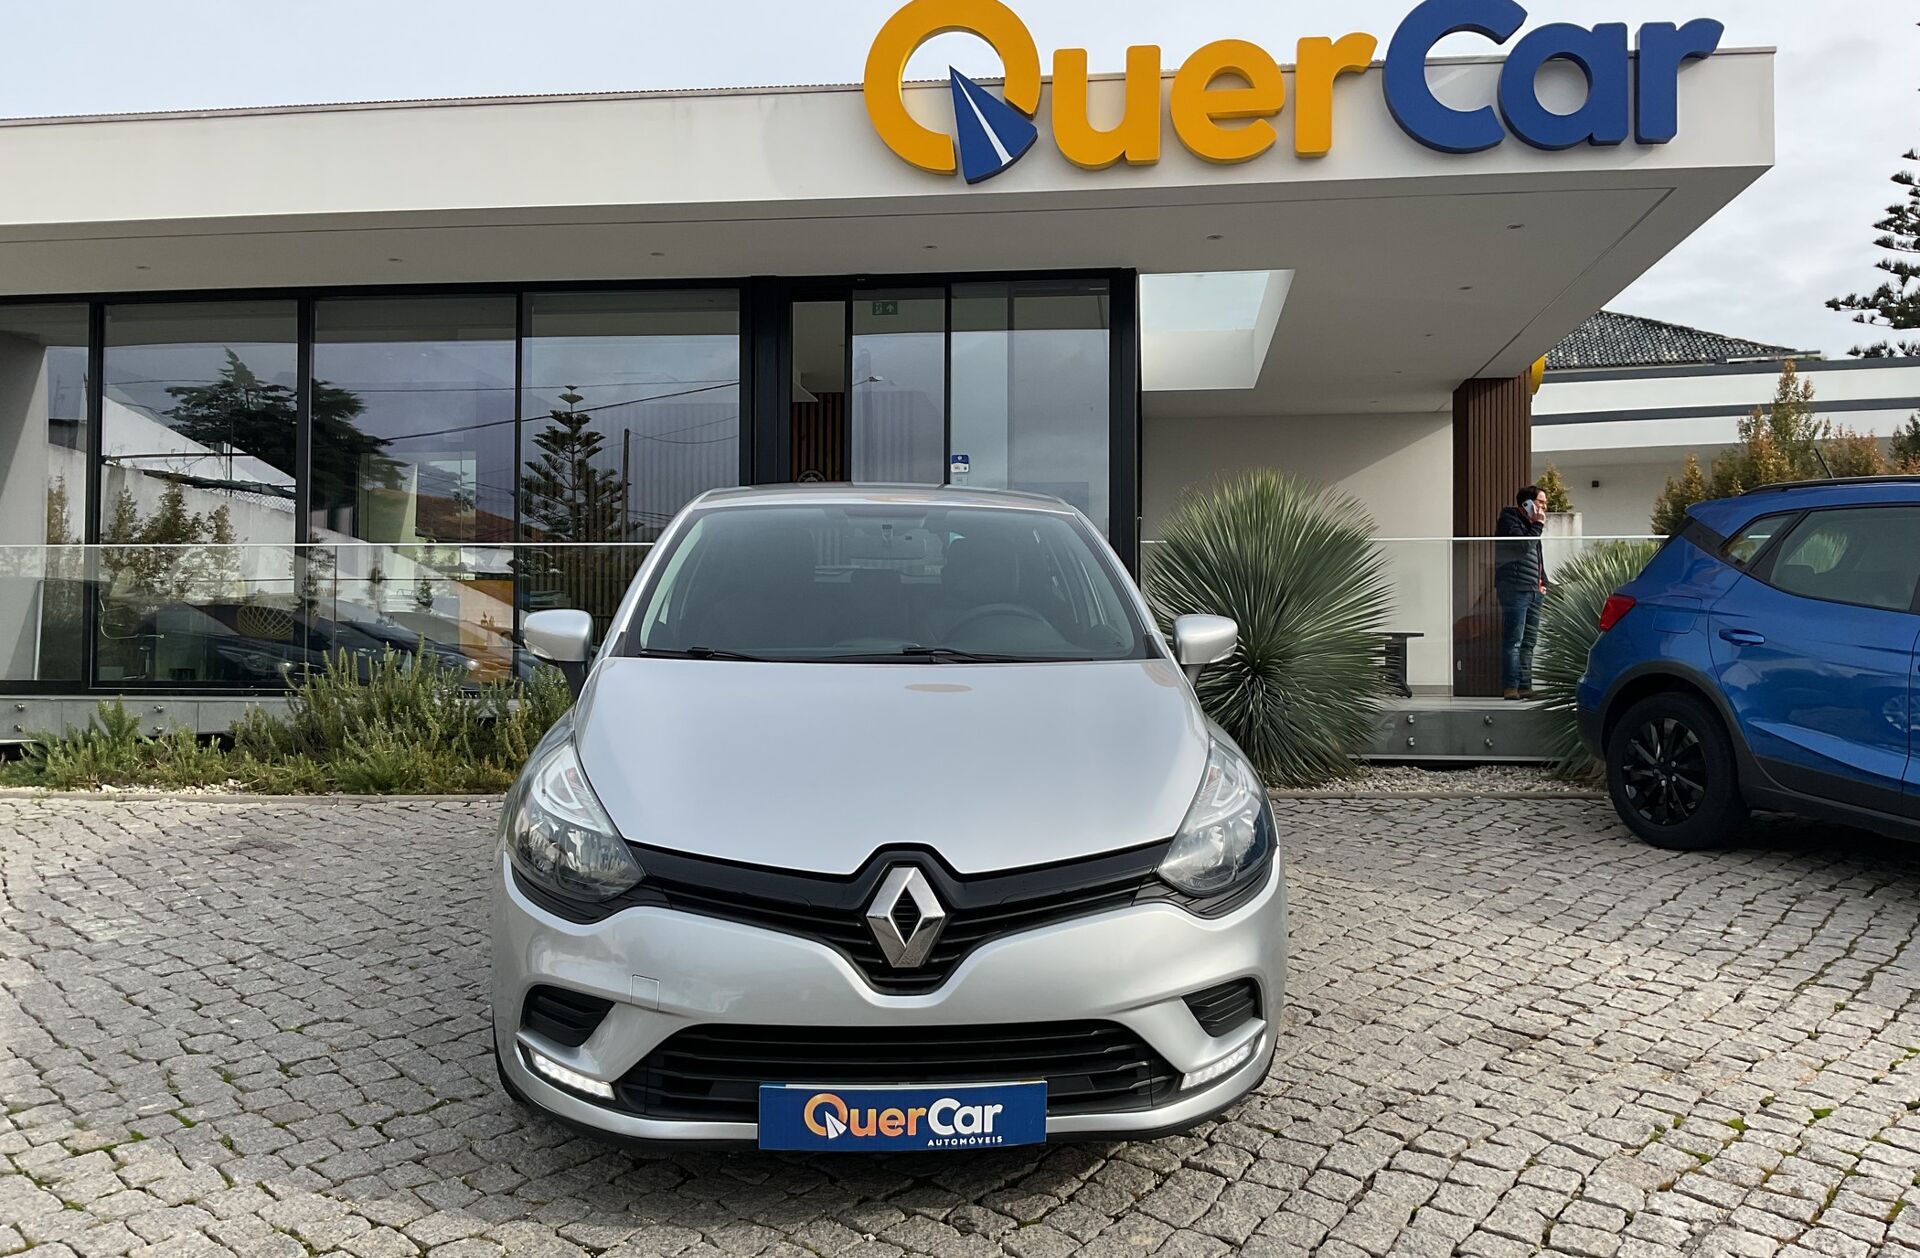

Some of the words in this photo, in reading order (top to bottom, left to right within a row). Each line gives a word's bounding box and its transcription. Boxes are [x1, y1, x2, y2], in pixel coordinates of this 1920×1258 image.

[864, 0, 1724, 184] QuerCar
[804, 1093, 1003, 1139] QuerCar
[927, 1135, 1003, 1147] AUTOMÓVEIS
